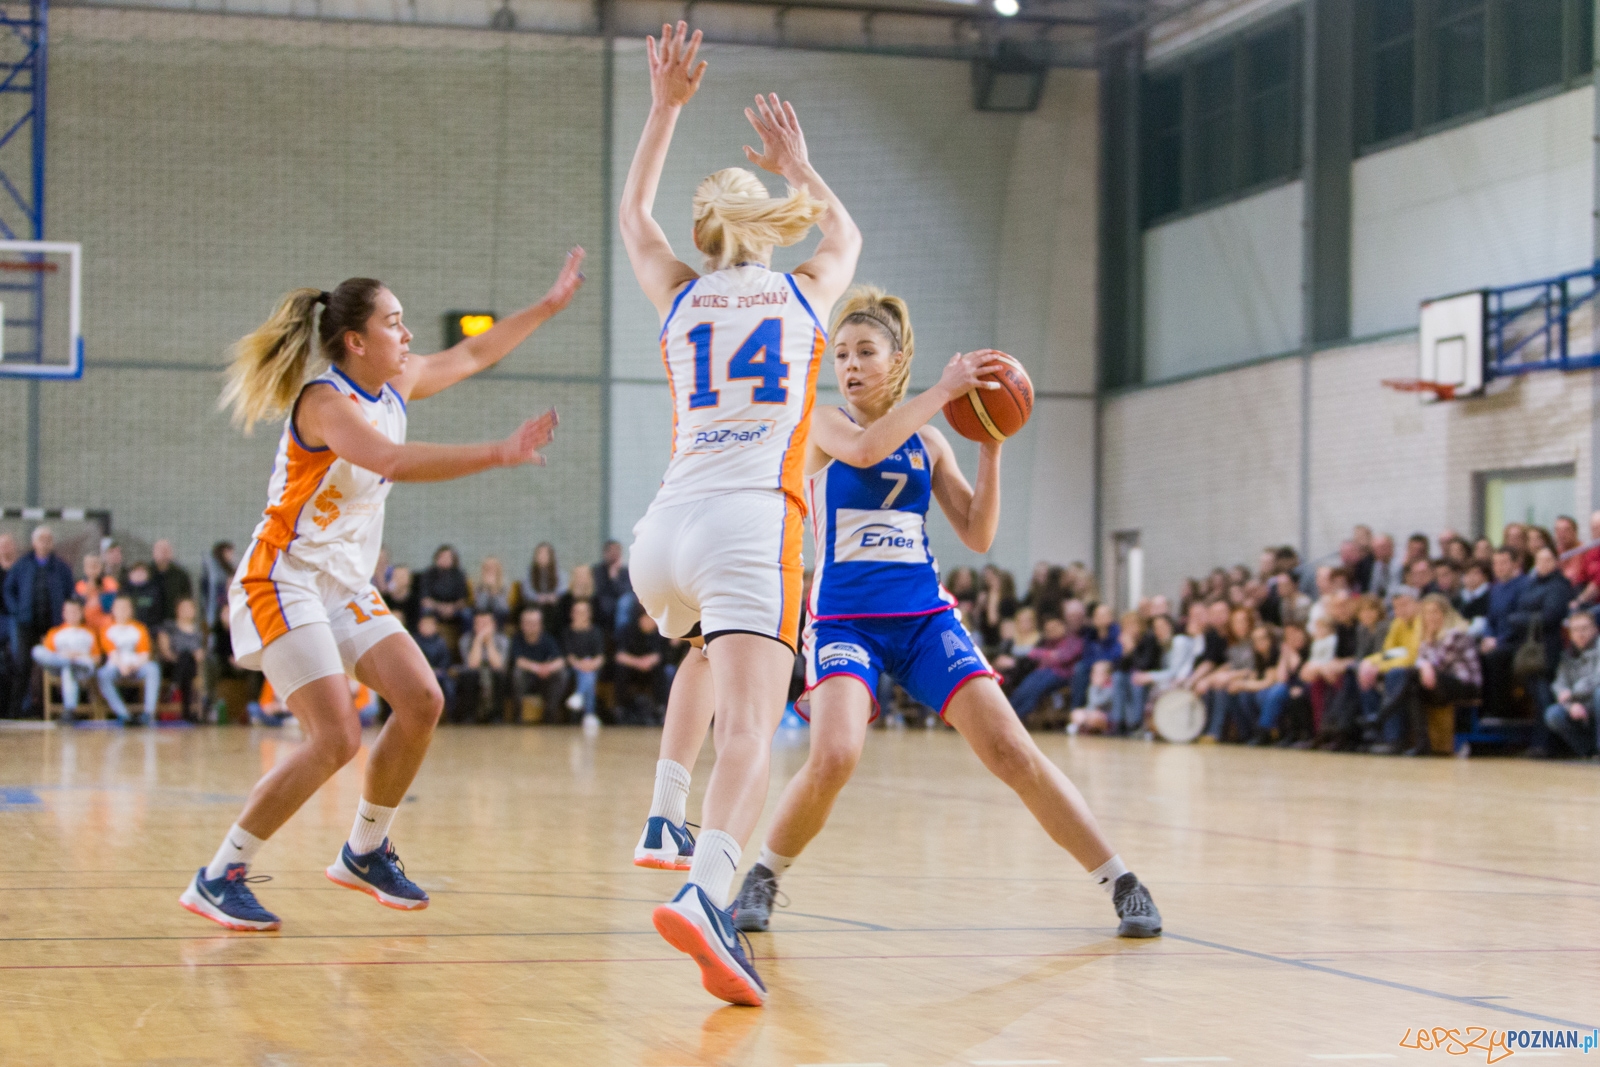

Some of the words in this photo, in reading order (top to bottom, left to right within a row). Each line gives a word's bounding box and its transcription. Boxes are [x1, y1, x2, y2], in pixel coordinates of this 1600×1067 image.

[691, 294, 729, 308] MUKS
[686, 316, 790, 411] 14
[880, 471, 908, 510] 7
[860, 532, 914, 549] Enea
[345, 590, 392, 625] 13
